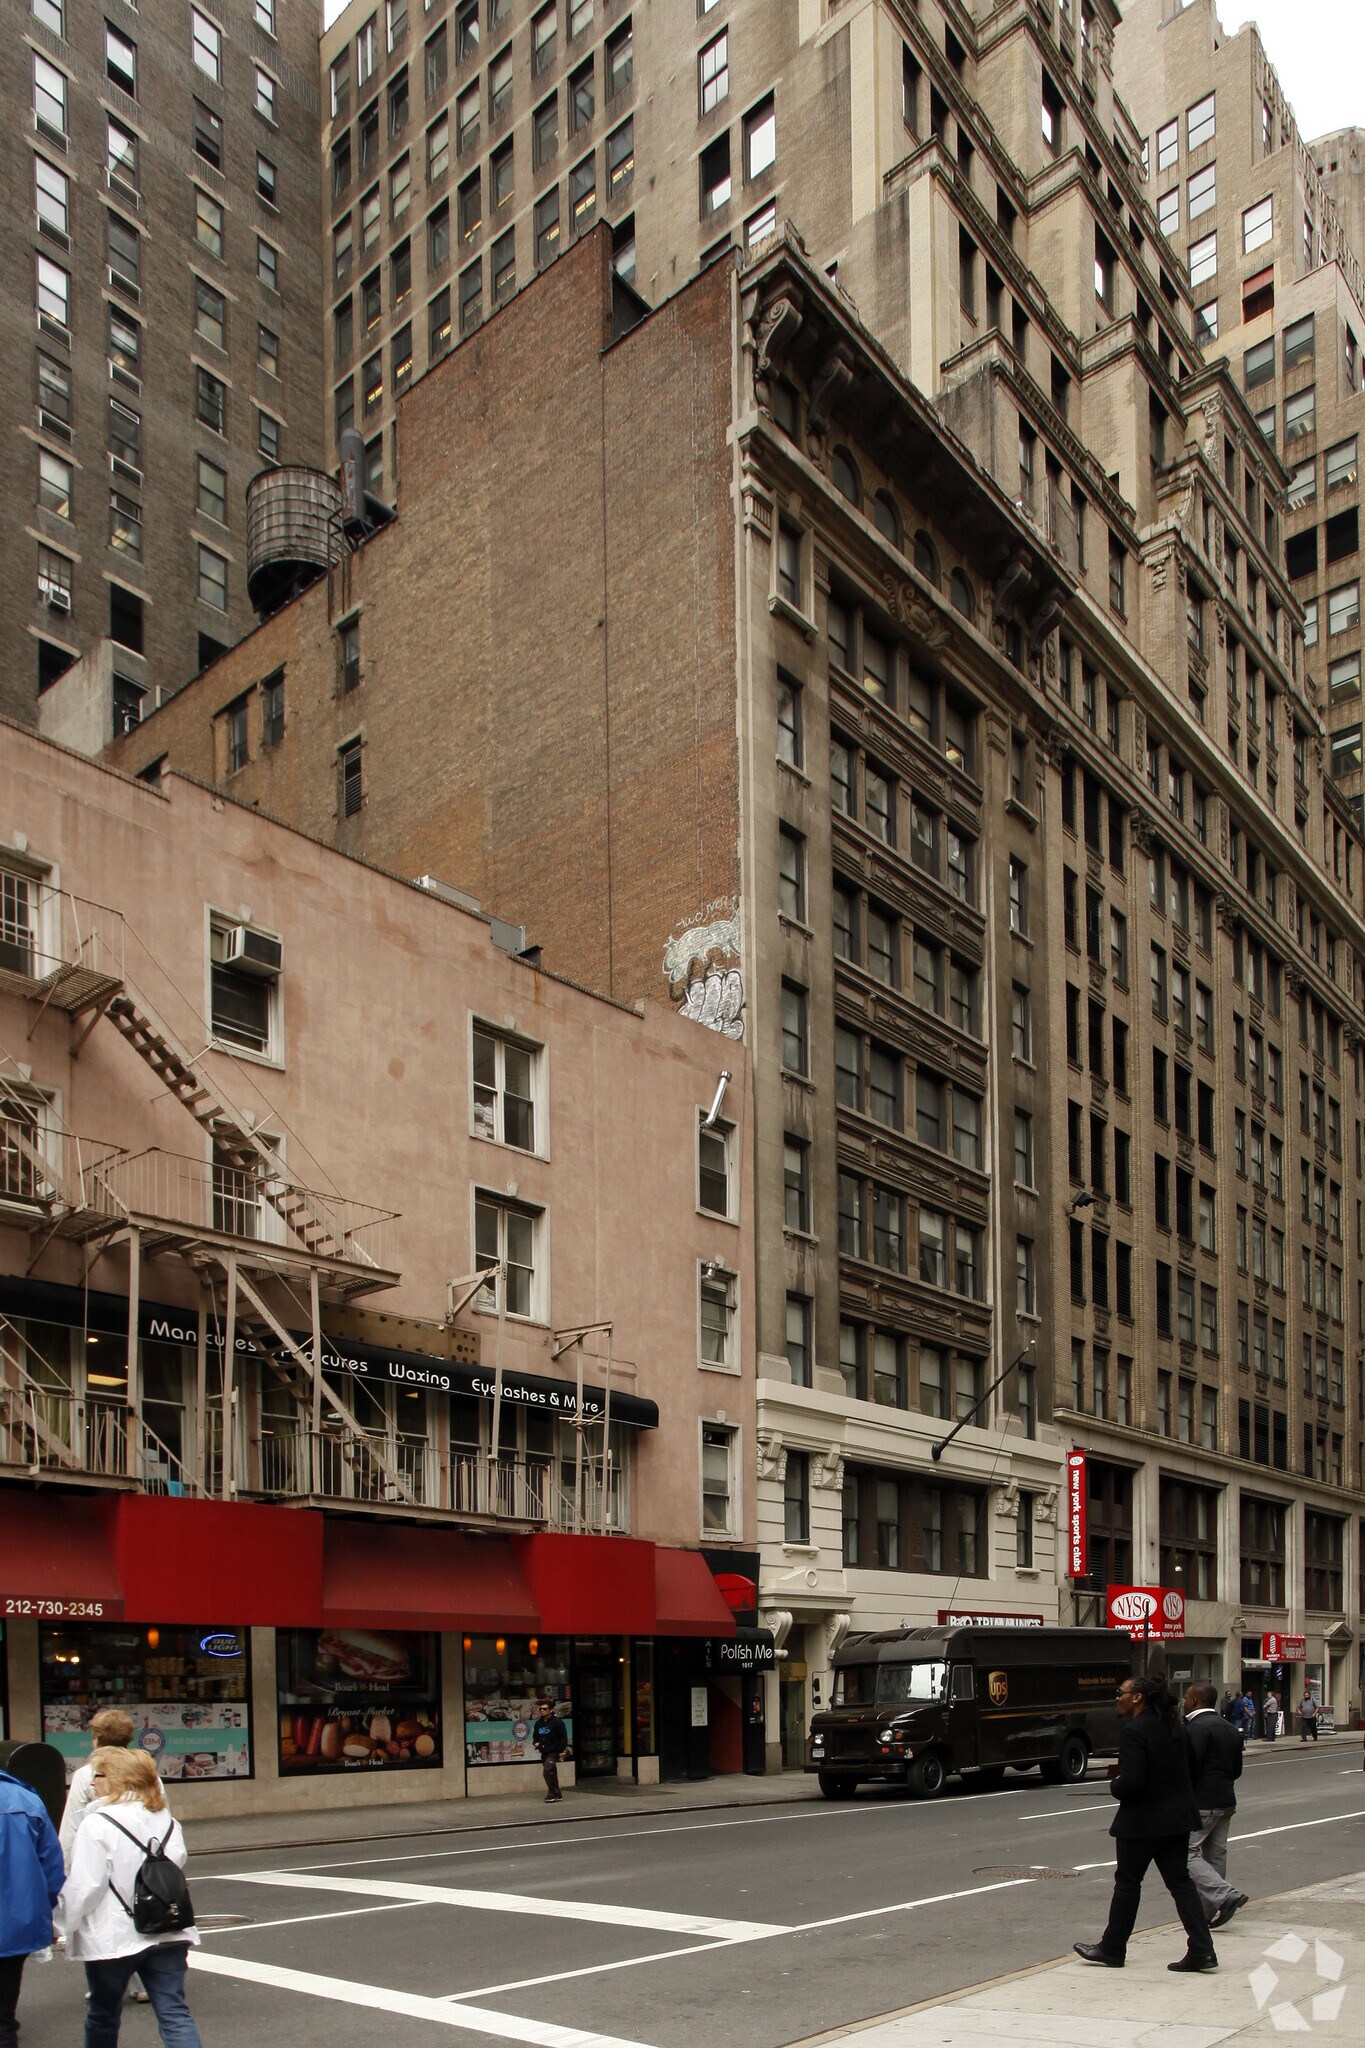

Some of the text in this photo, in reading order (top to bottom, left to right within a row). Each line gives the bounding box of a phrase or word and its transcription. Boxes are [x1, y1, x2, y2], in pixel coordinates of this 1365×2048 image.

[151, 1319, 257, 1351] Mancues
[389, 1362, 450, 1389] Waxing
[471, 1378, 546, 1403] Eyelashes
[550, 1392, 560, 1406] &
[1071, 1469, 1082, 1572] new york sports clubs
[5, 1599, 103, 1617] 212-730-2345
[1134, 1622, 1154, 1631] yok
[754, 1644, 773, 1659] Me
[369, 1682, 390, 1692] Head
[990, 1681, 1007, 1701] ups
[361, 1706, 395, 1716] Market
[143, 1737, 162, 1746] BM
